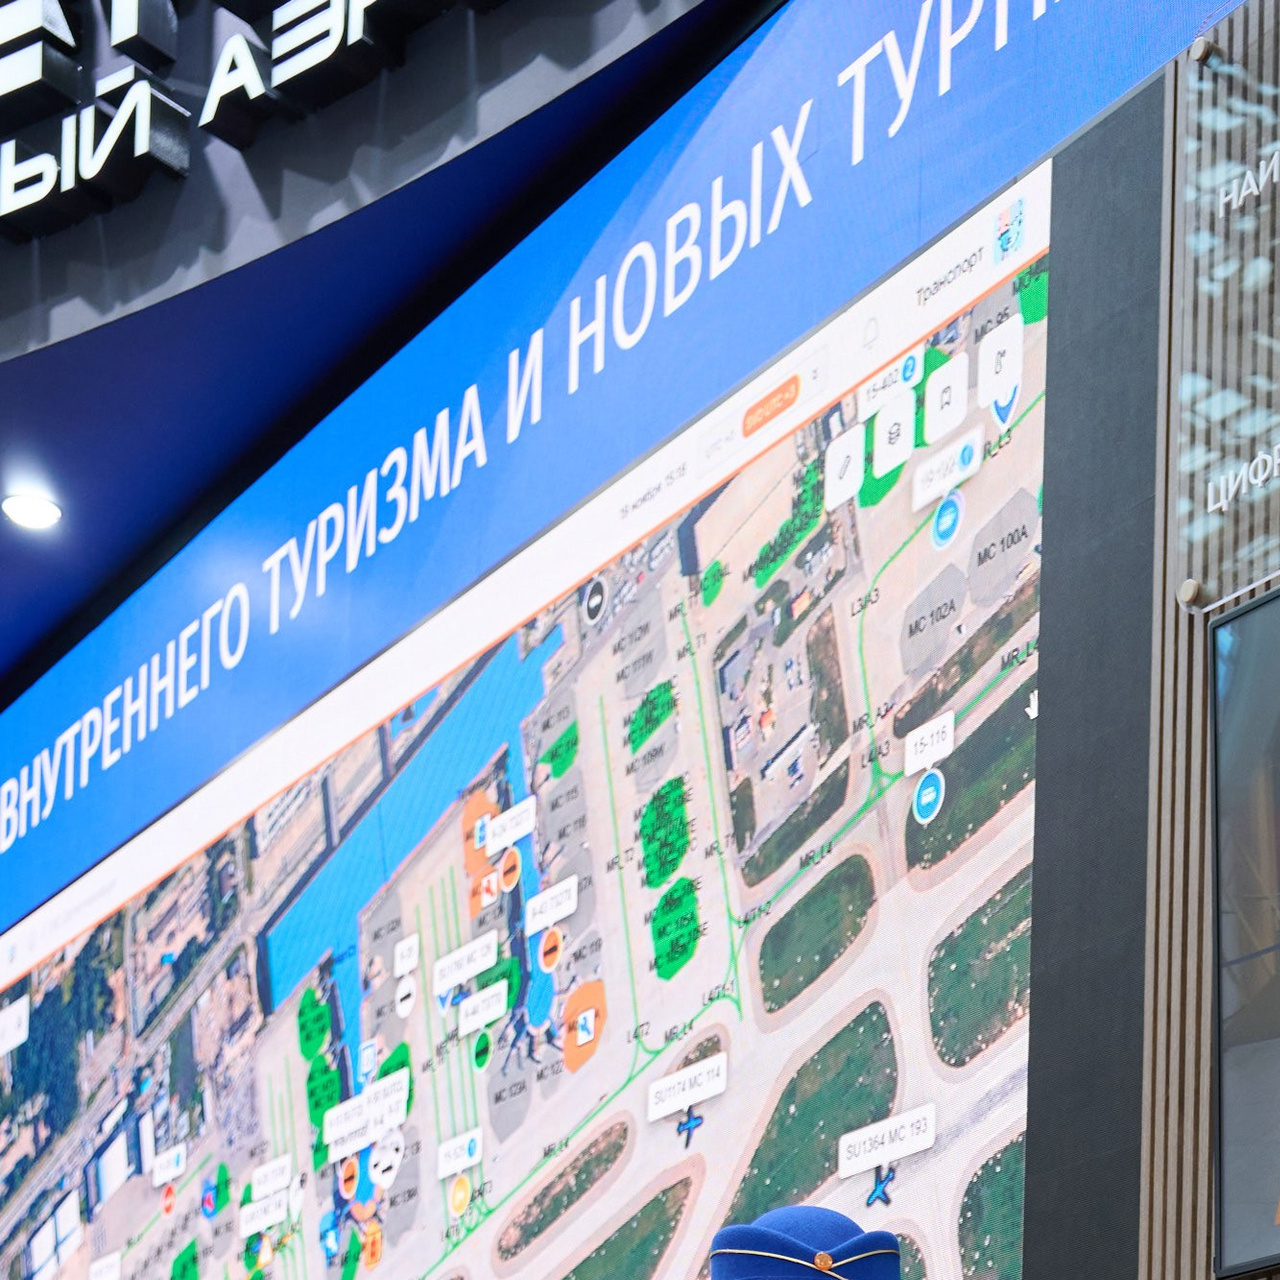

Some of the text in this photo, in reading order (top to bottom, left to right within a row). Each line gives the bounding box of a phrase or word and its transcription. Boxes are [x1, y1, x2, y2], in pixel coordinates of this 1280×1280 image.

[0, 582, 250, 853] ВНУТРЕННЕГО
[262, 384, 487, 635] ТУРИЗМА
[506, 327, 543, 444] И
[569, 100, 813, 394] НОВЫХ
